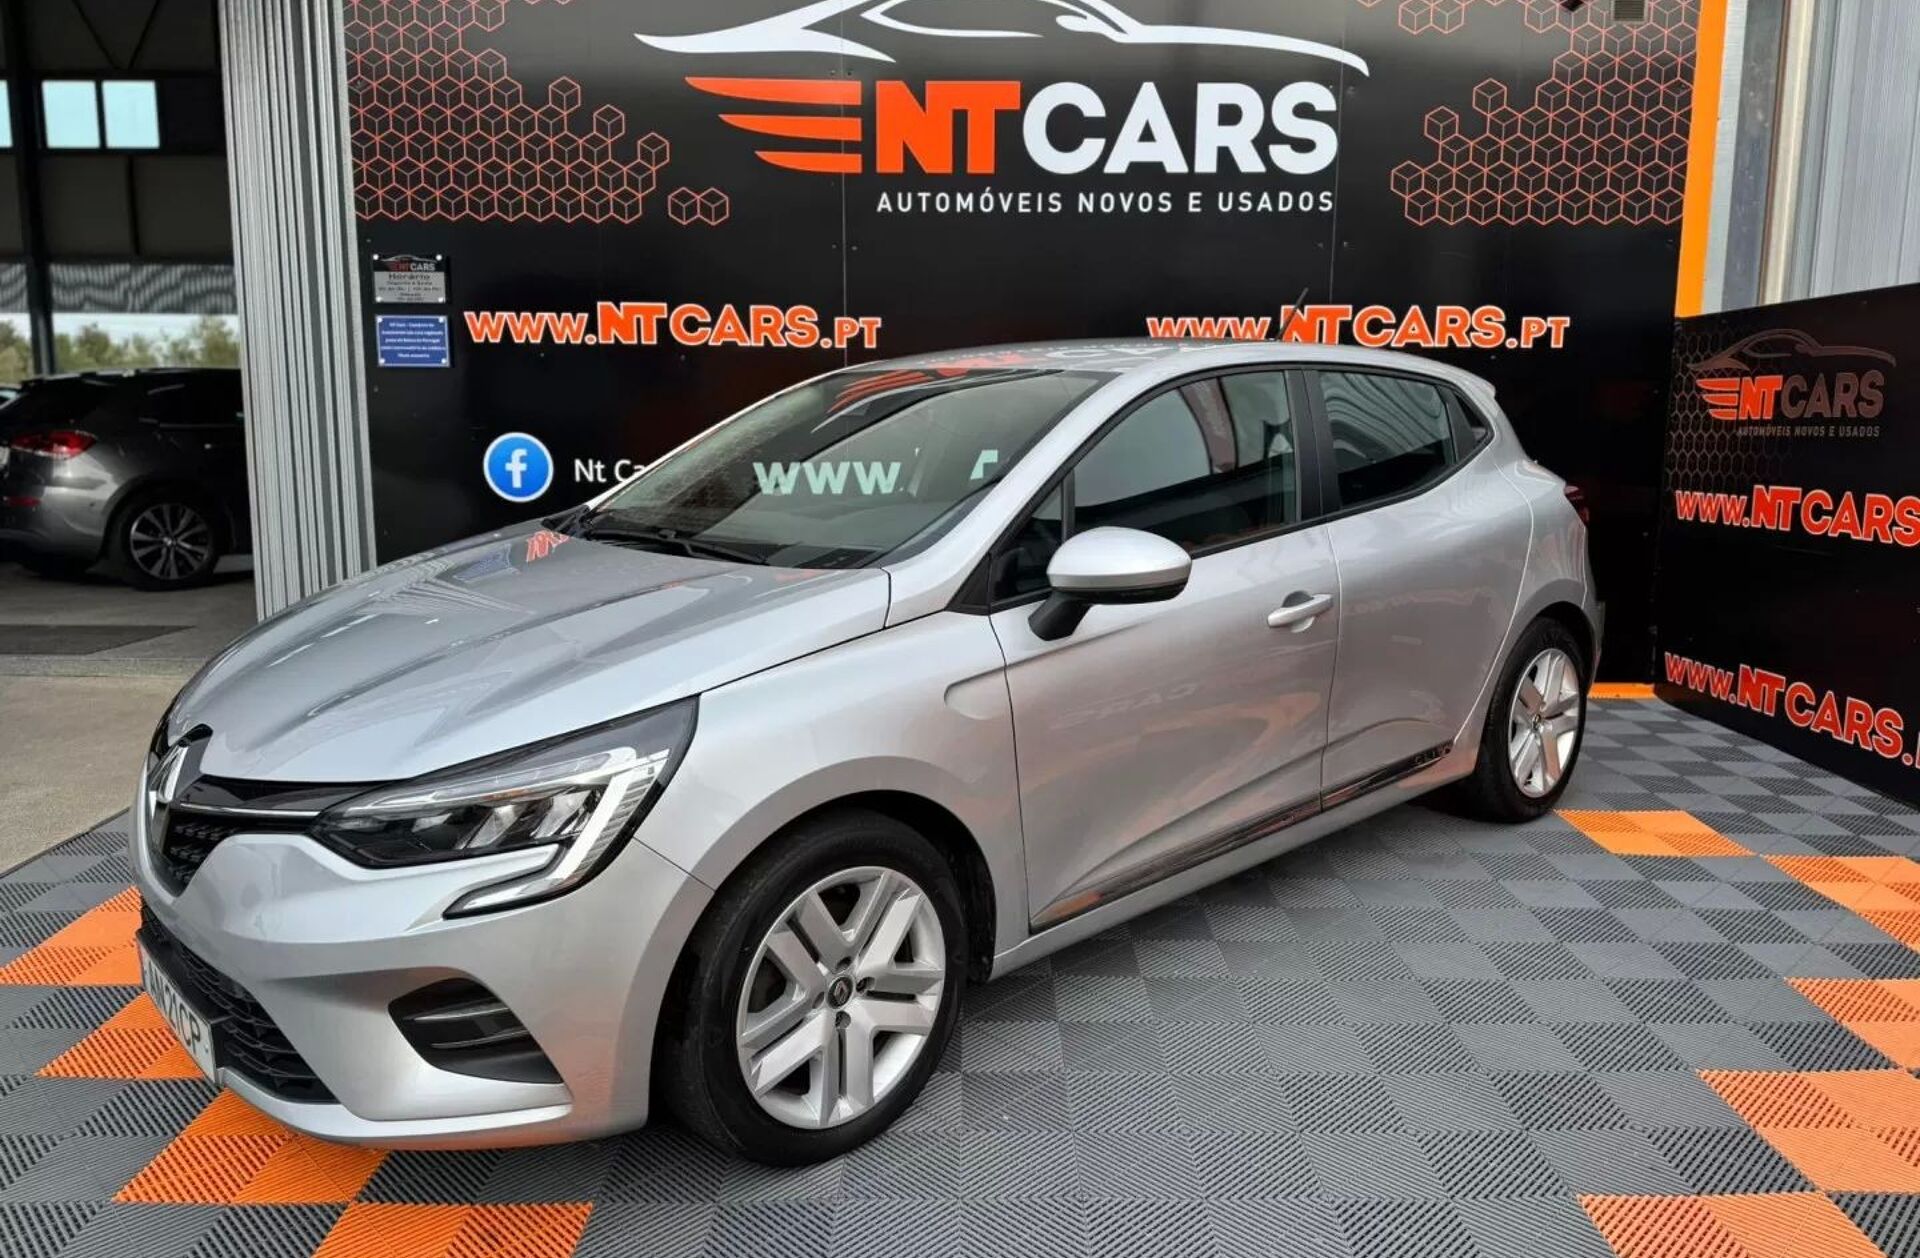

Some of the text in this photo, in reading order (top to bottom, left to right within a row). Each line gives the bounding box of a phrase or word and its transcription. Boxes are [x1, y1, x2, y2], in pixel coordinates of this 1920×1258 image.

[877, 187, 1334, 213] AUTOMÓVEIS NOVOS E USADOS
[1794, 425, 1825, 437] NOVOS
[1828, 425, 1836, 437] E
[1839, 425, 1880, 437] USADOS
[574, 458, 607, 482] Nt
